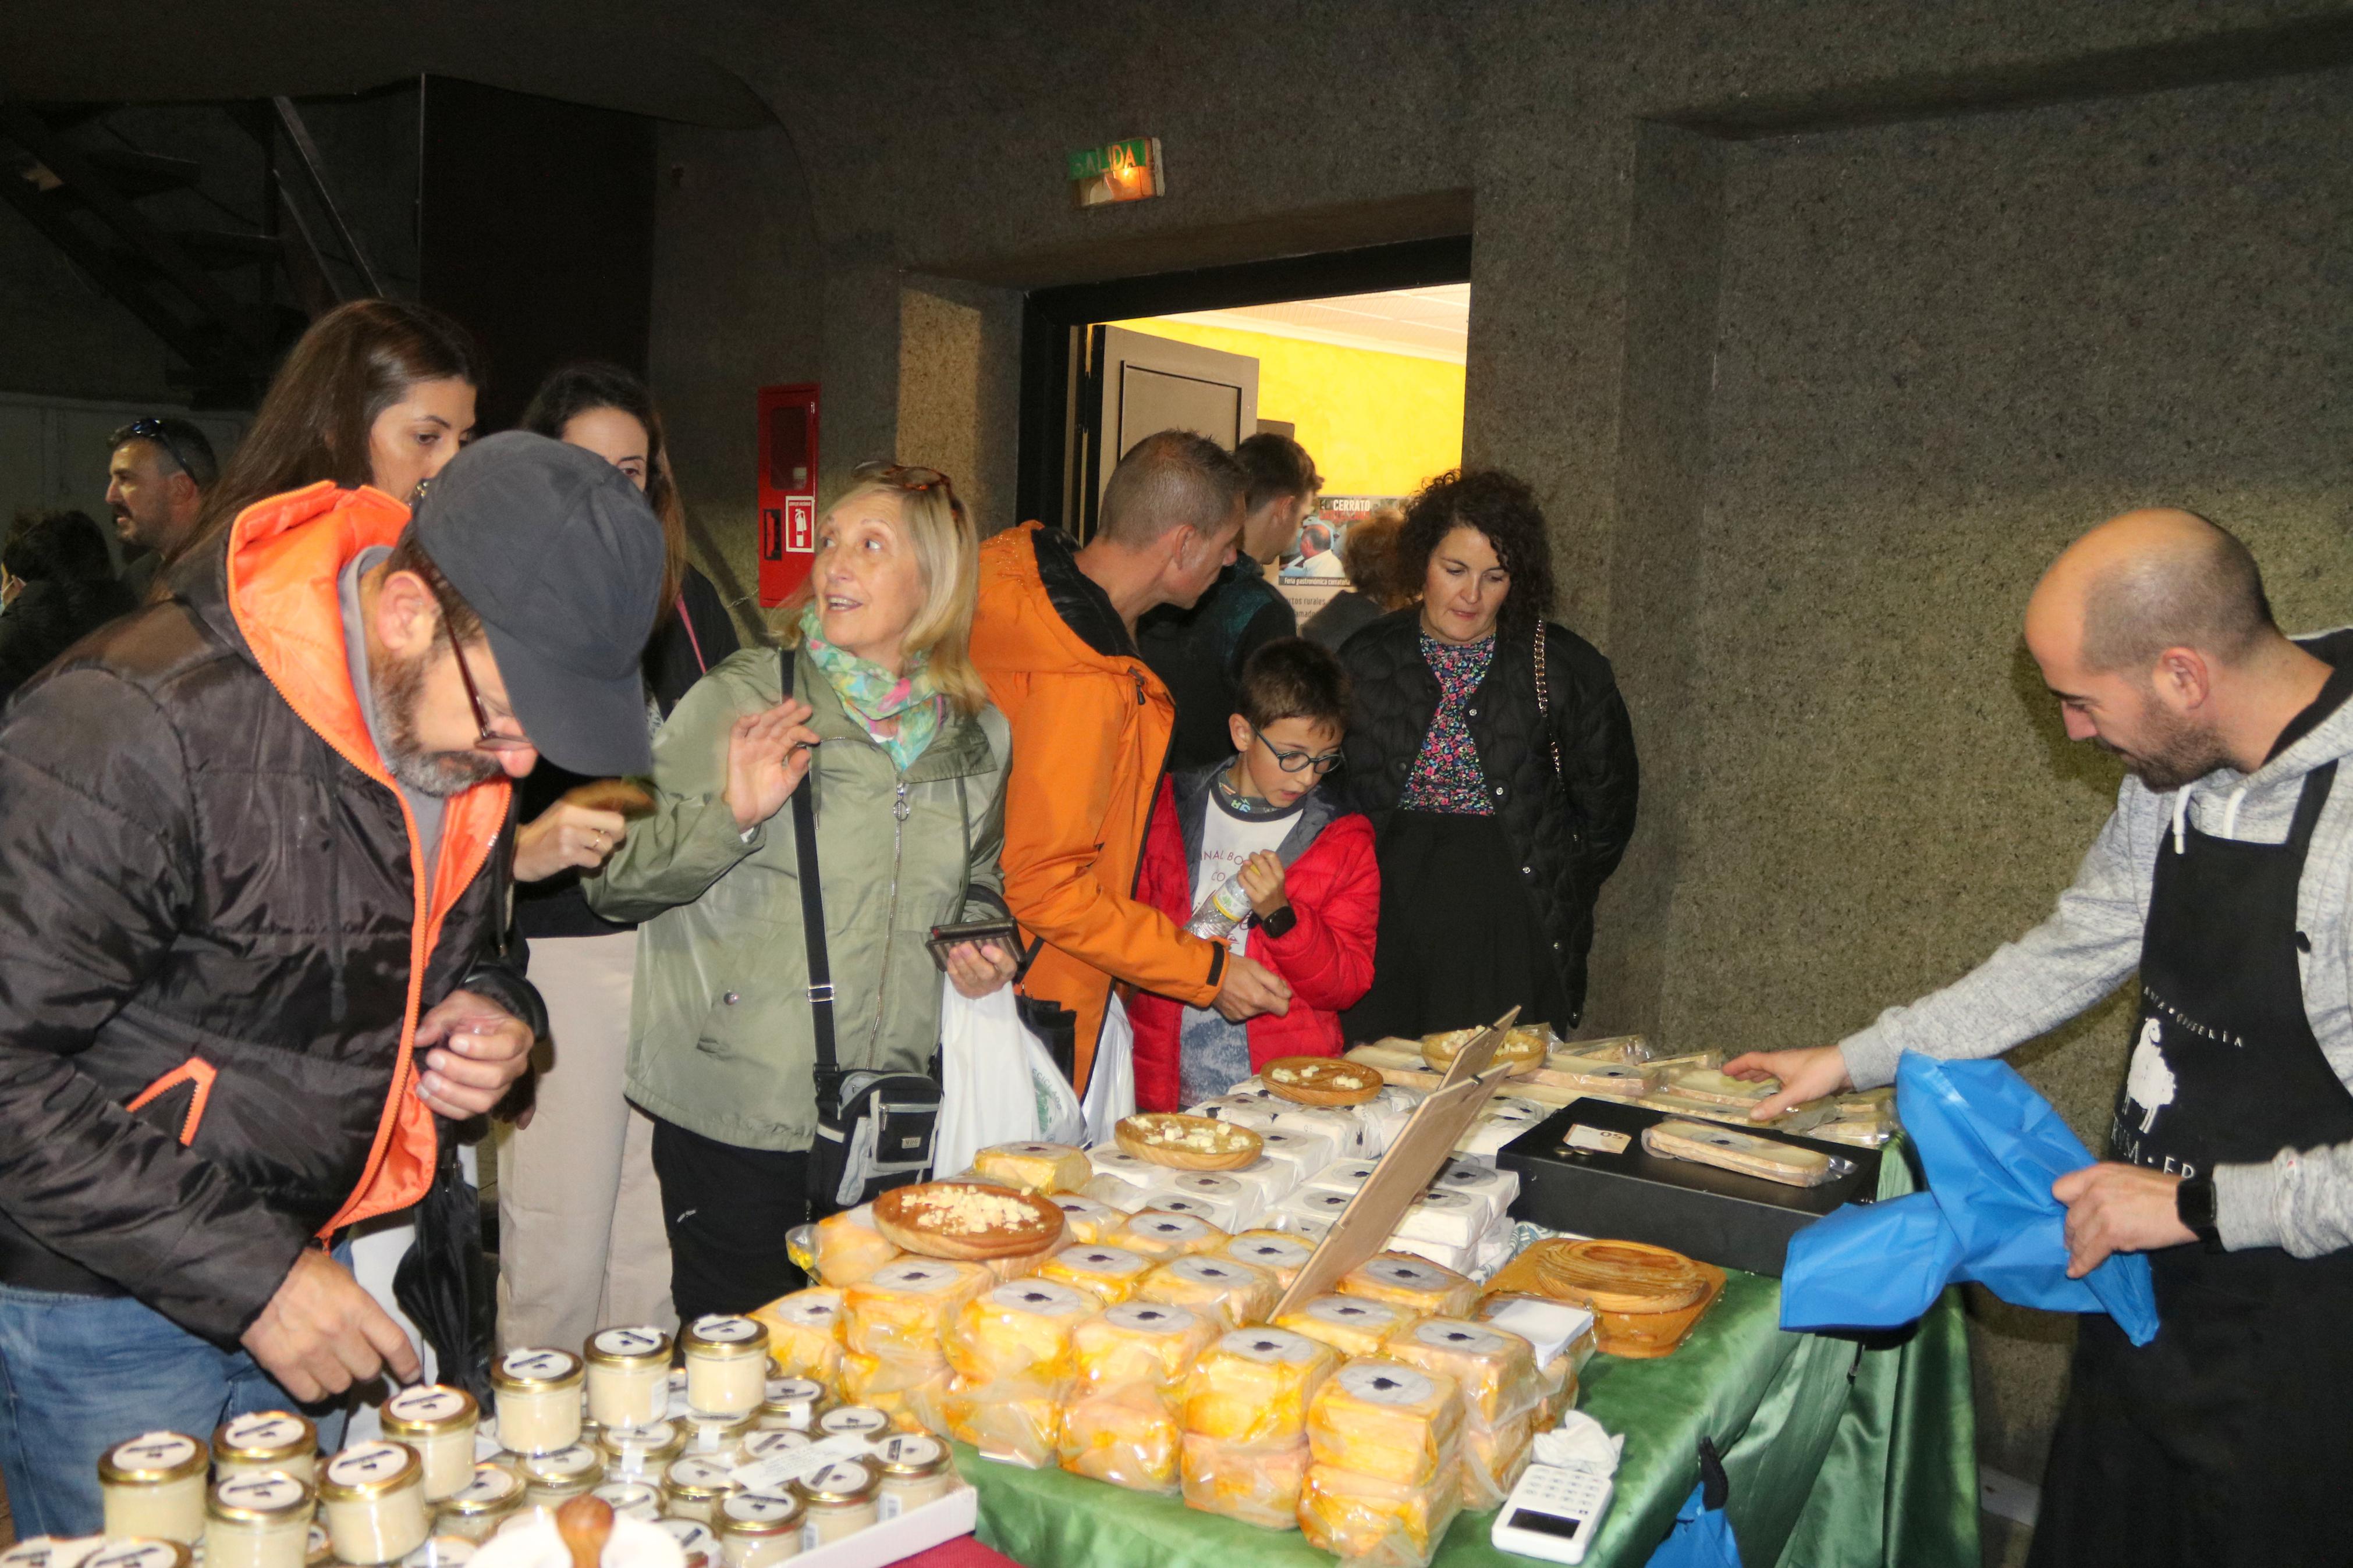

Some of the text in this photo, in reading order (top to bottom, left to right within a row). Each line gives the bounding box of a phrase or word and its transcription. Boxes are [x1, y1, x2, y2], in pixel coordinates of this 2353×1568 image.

[1073, 144, 1136, 175] SALIDA
[1333, 499, 1371, 511] CERRATO
[1600, 1132, 1624, 1140] 50
